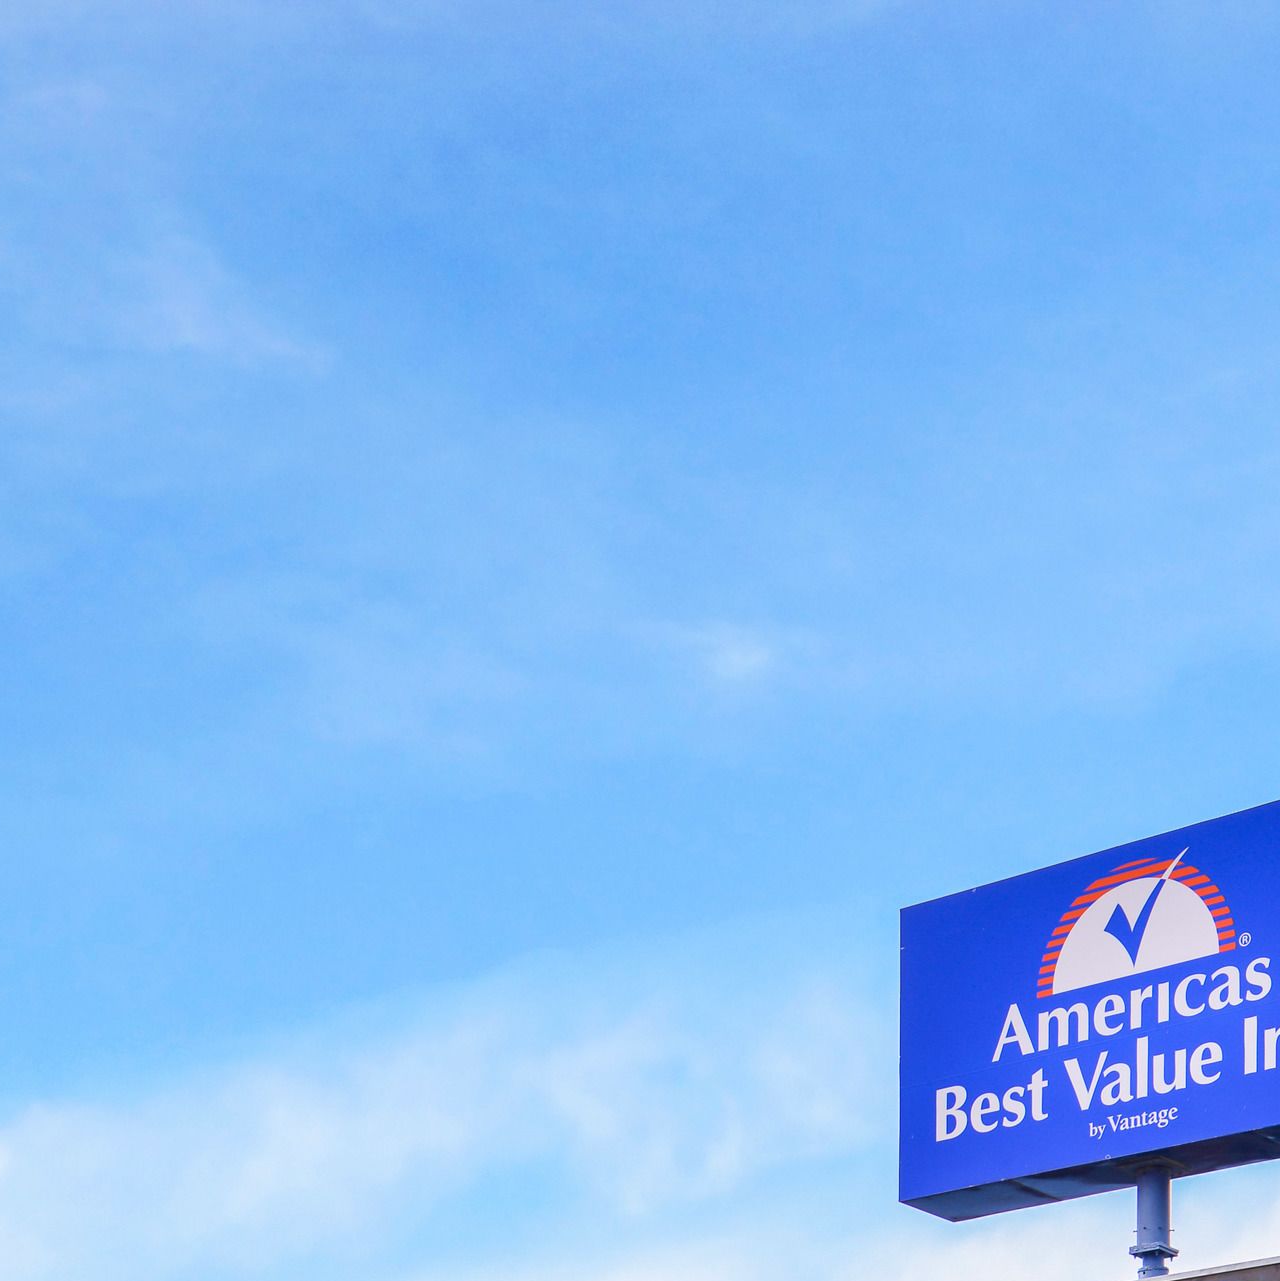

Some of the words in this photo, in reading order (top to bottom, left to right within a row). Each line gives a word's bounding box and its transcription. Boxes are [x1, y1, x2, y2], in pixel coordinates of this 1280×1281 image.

[991, 957, 1272, 1063] Americas
[935, 1067, 1049, 1142] Best
[1064, 1036, 1223, 1111] Value
[1088, 1121, 1107, 1140] by
[1106, 1106, 1179, 1133] Vantage
